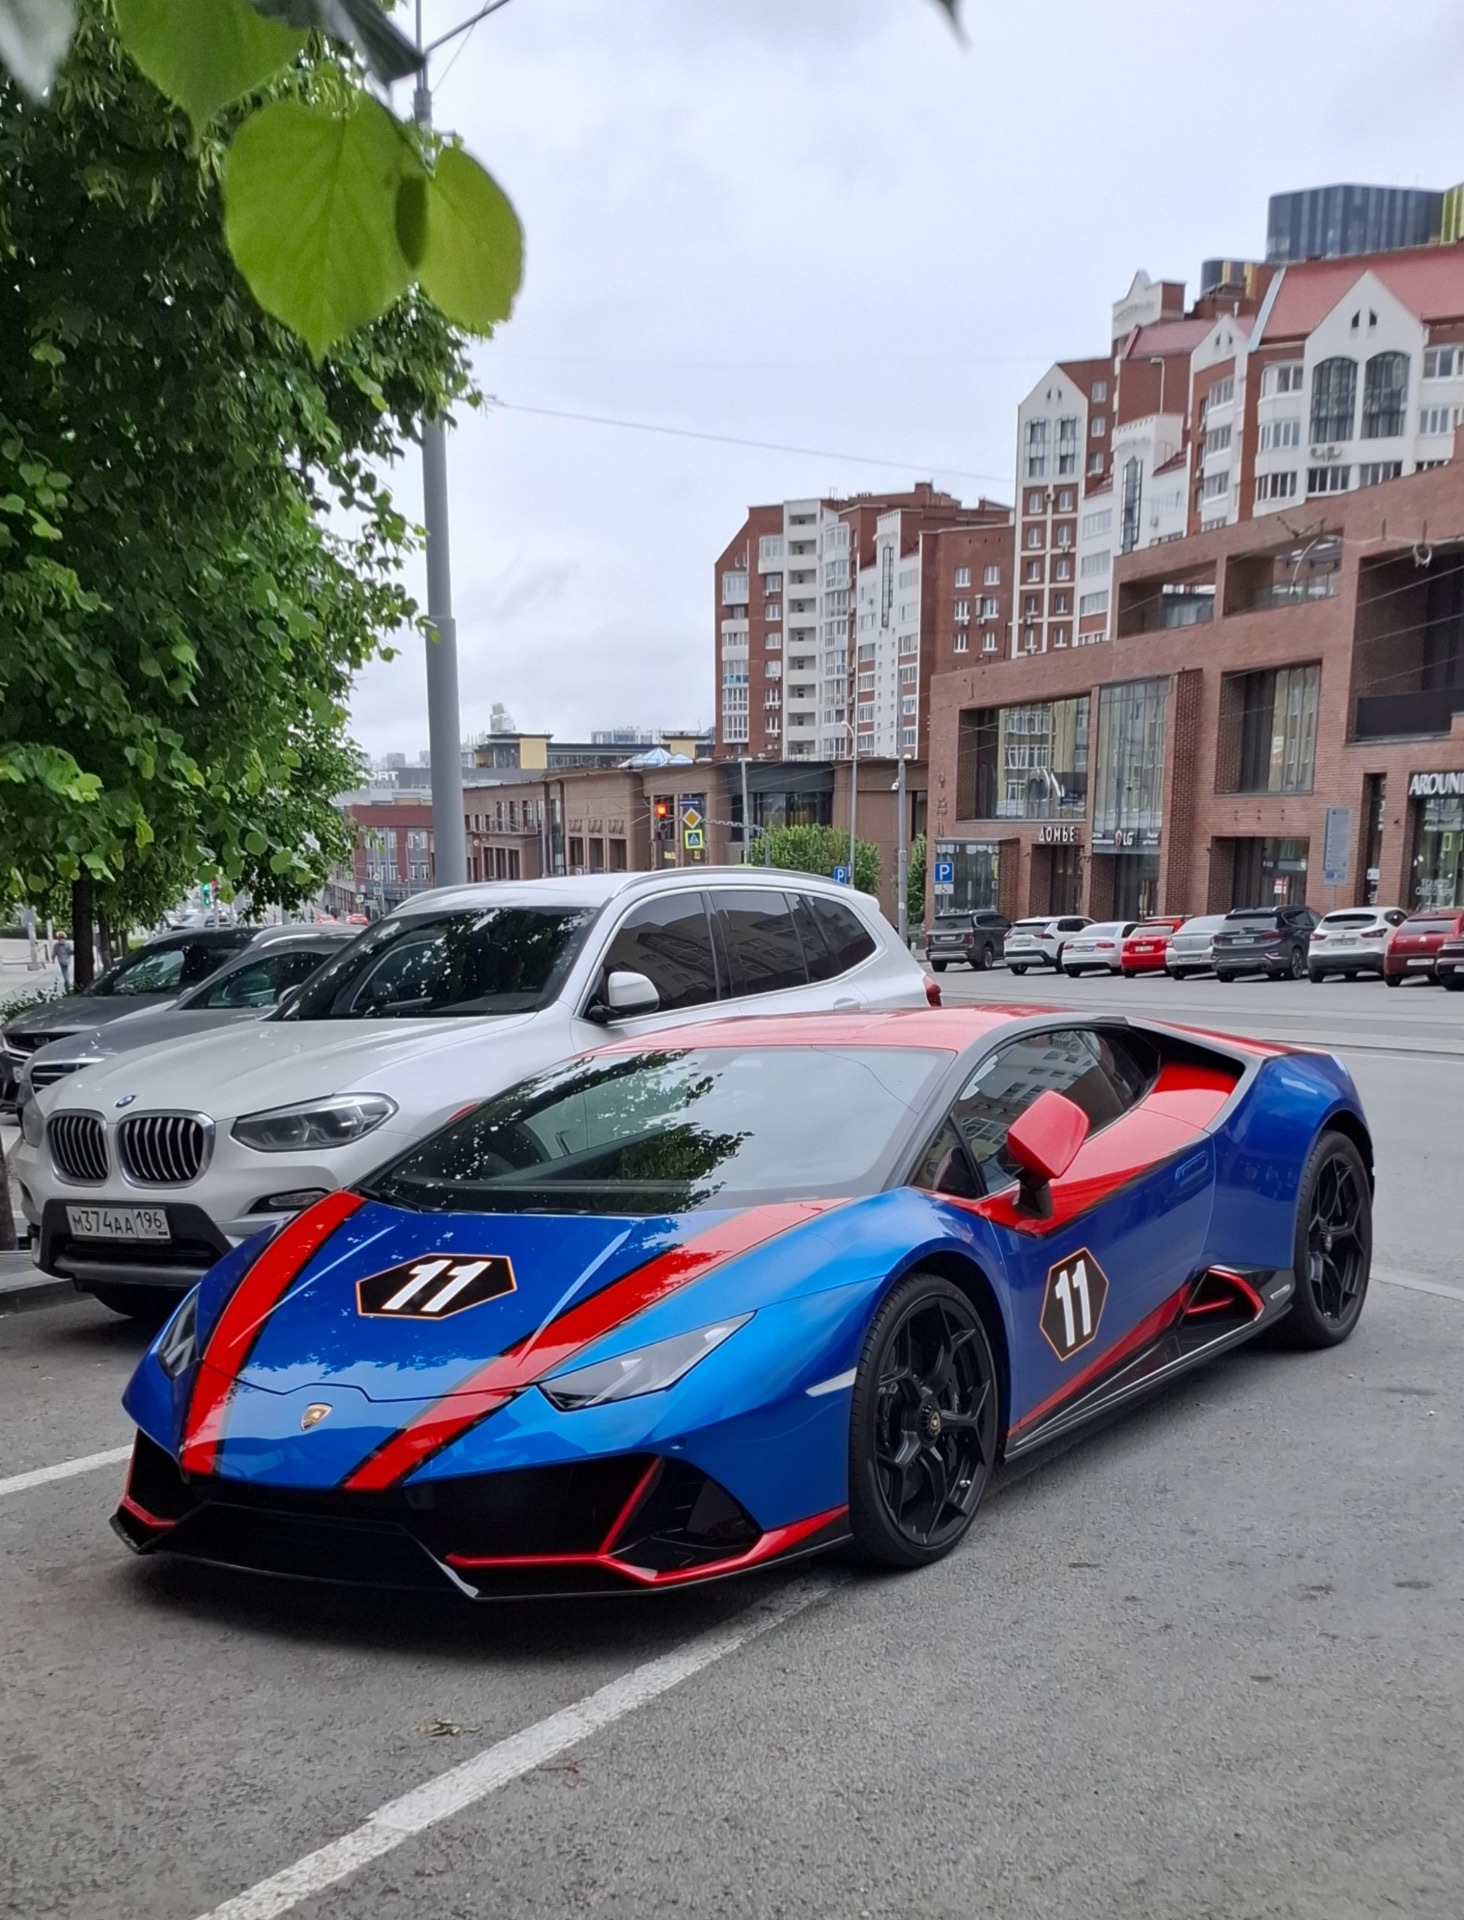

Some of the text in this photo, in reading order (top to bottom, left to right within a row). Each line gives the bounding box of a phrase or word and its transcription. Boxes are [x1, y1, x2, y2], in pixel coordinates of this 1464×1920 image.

[136, 1211, 162, 1229] 196
[381, 1259, 493, 1313] 11
[1055, 1259, 1092, 1348] 11
